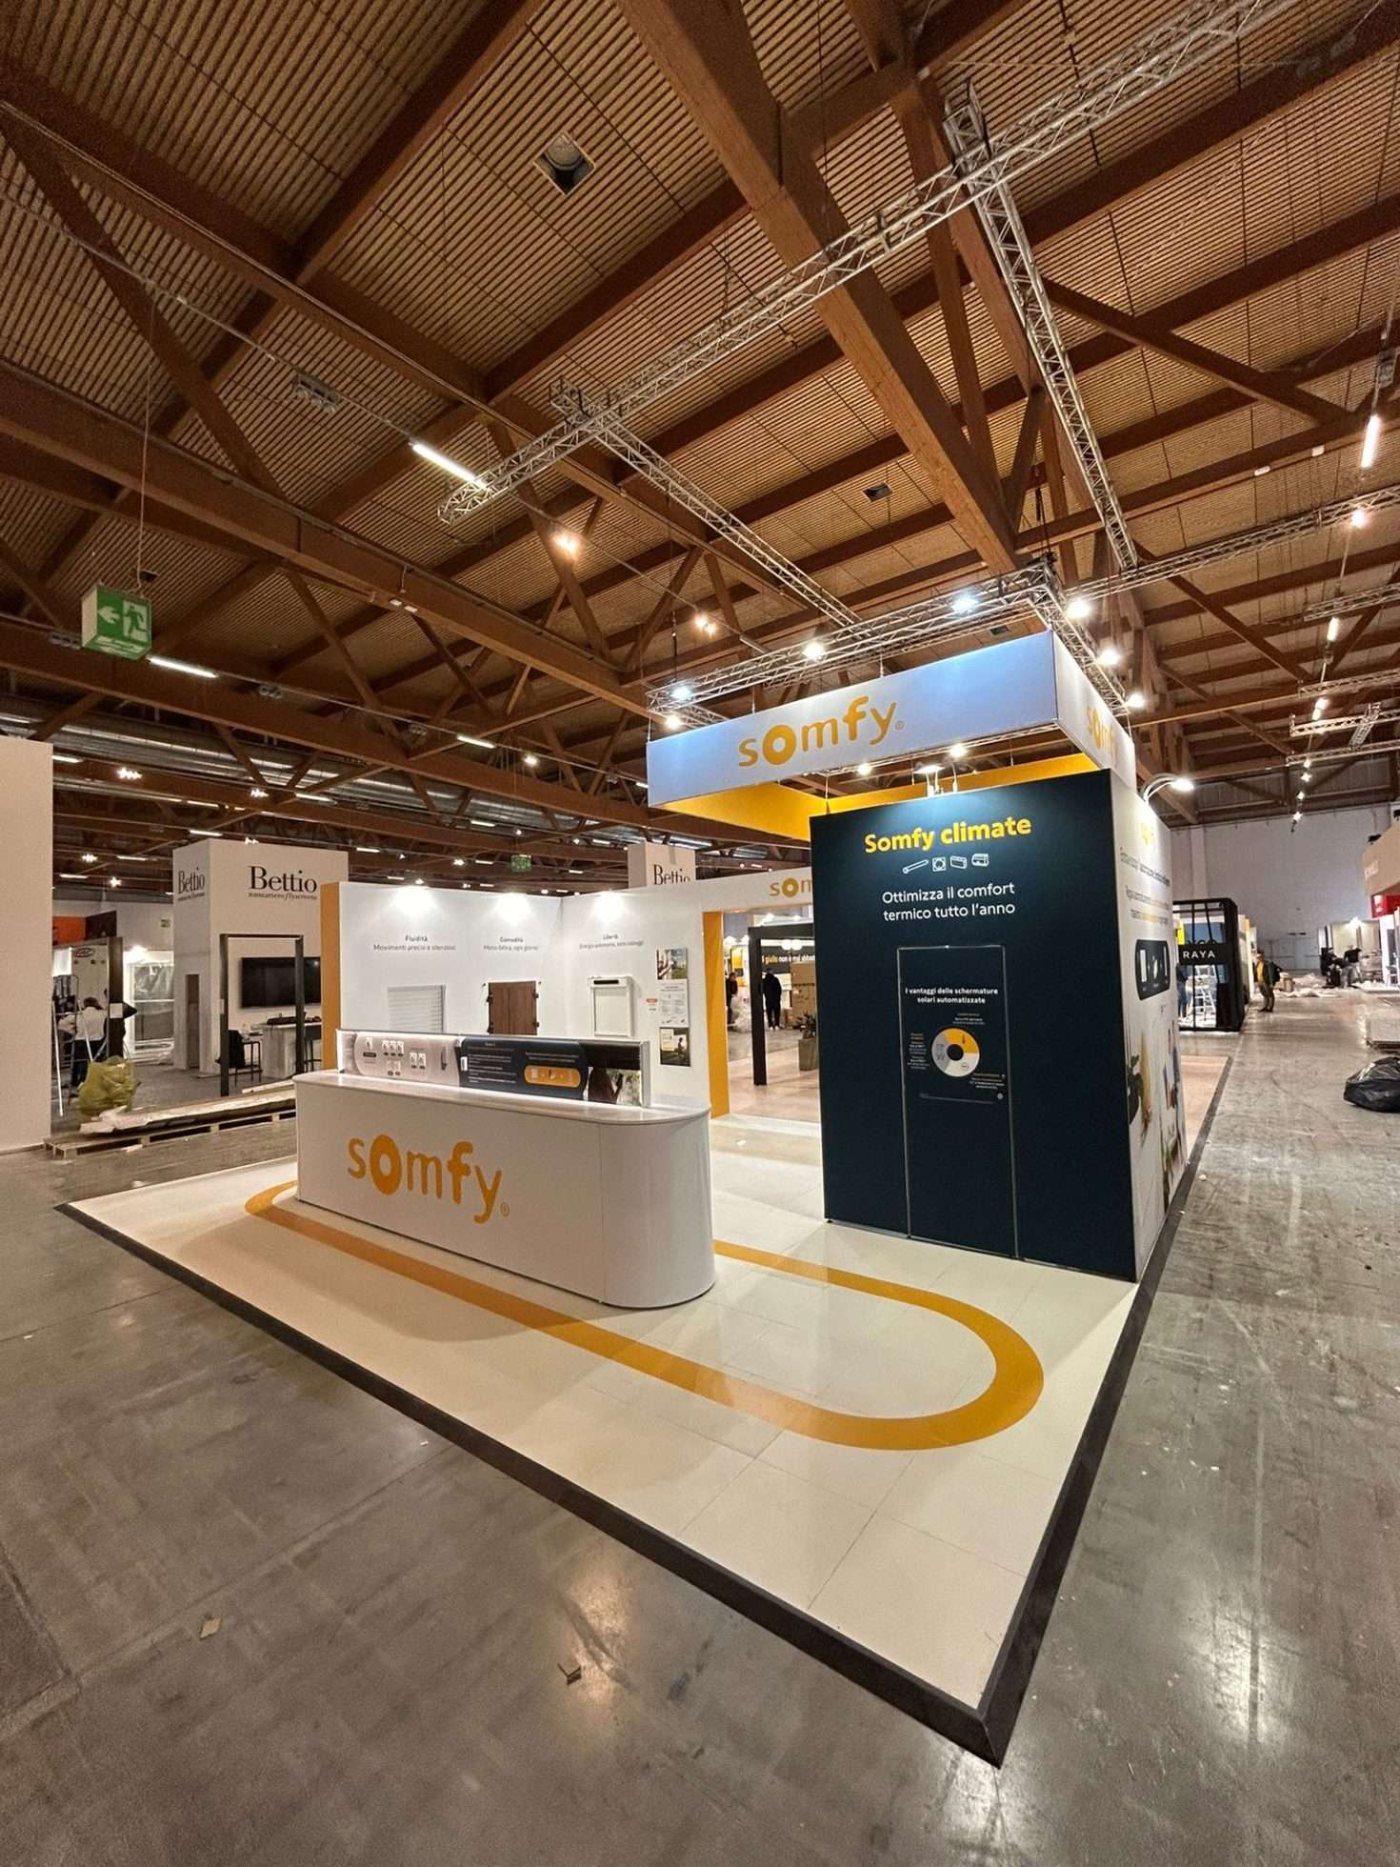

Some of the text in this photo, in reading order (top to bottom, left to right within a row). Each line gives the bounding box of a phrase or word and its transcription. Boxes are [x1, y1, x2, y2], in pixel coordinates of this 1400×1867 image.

[864, 816, 1032, 853] Somfy climate
[178, 867, 206, 894] Bettio
[249, 865, 317, 893] Bettio
[882, 882, 1015, 904] Ottimizza il comfort
[883, 903, 1016, 921] termico tutto l'anno
[1183, 950, 1216, 959] RAYA
[909, 987, 936, 995] vantaggi
[937, 996, 986, 1004] automatizzate
